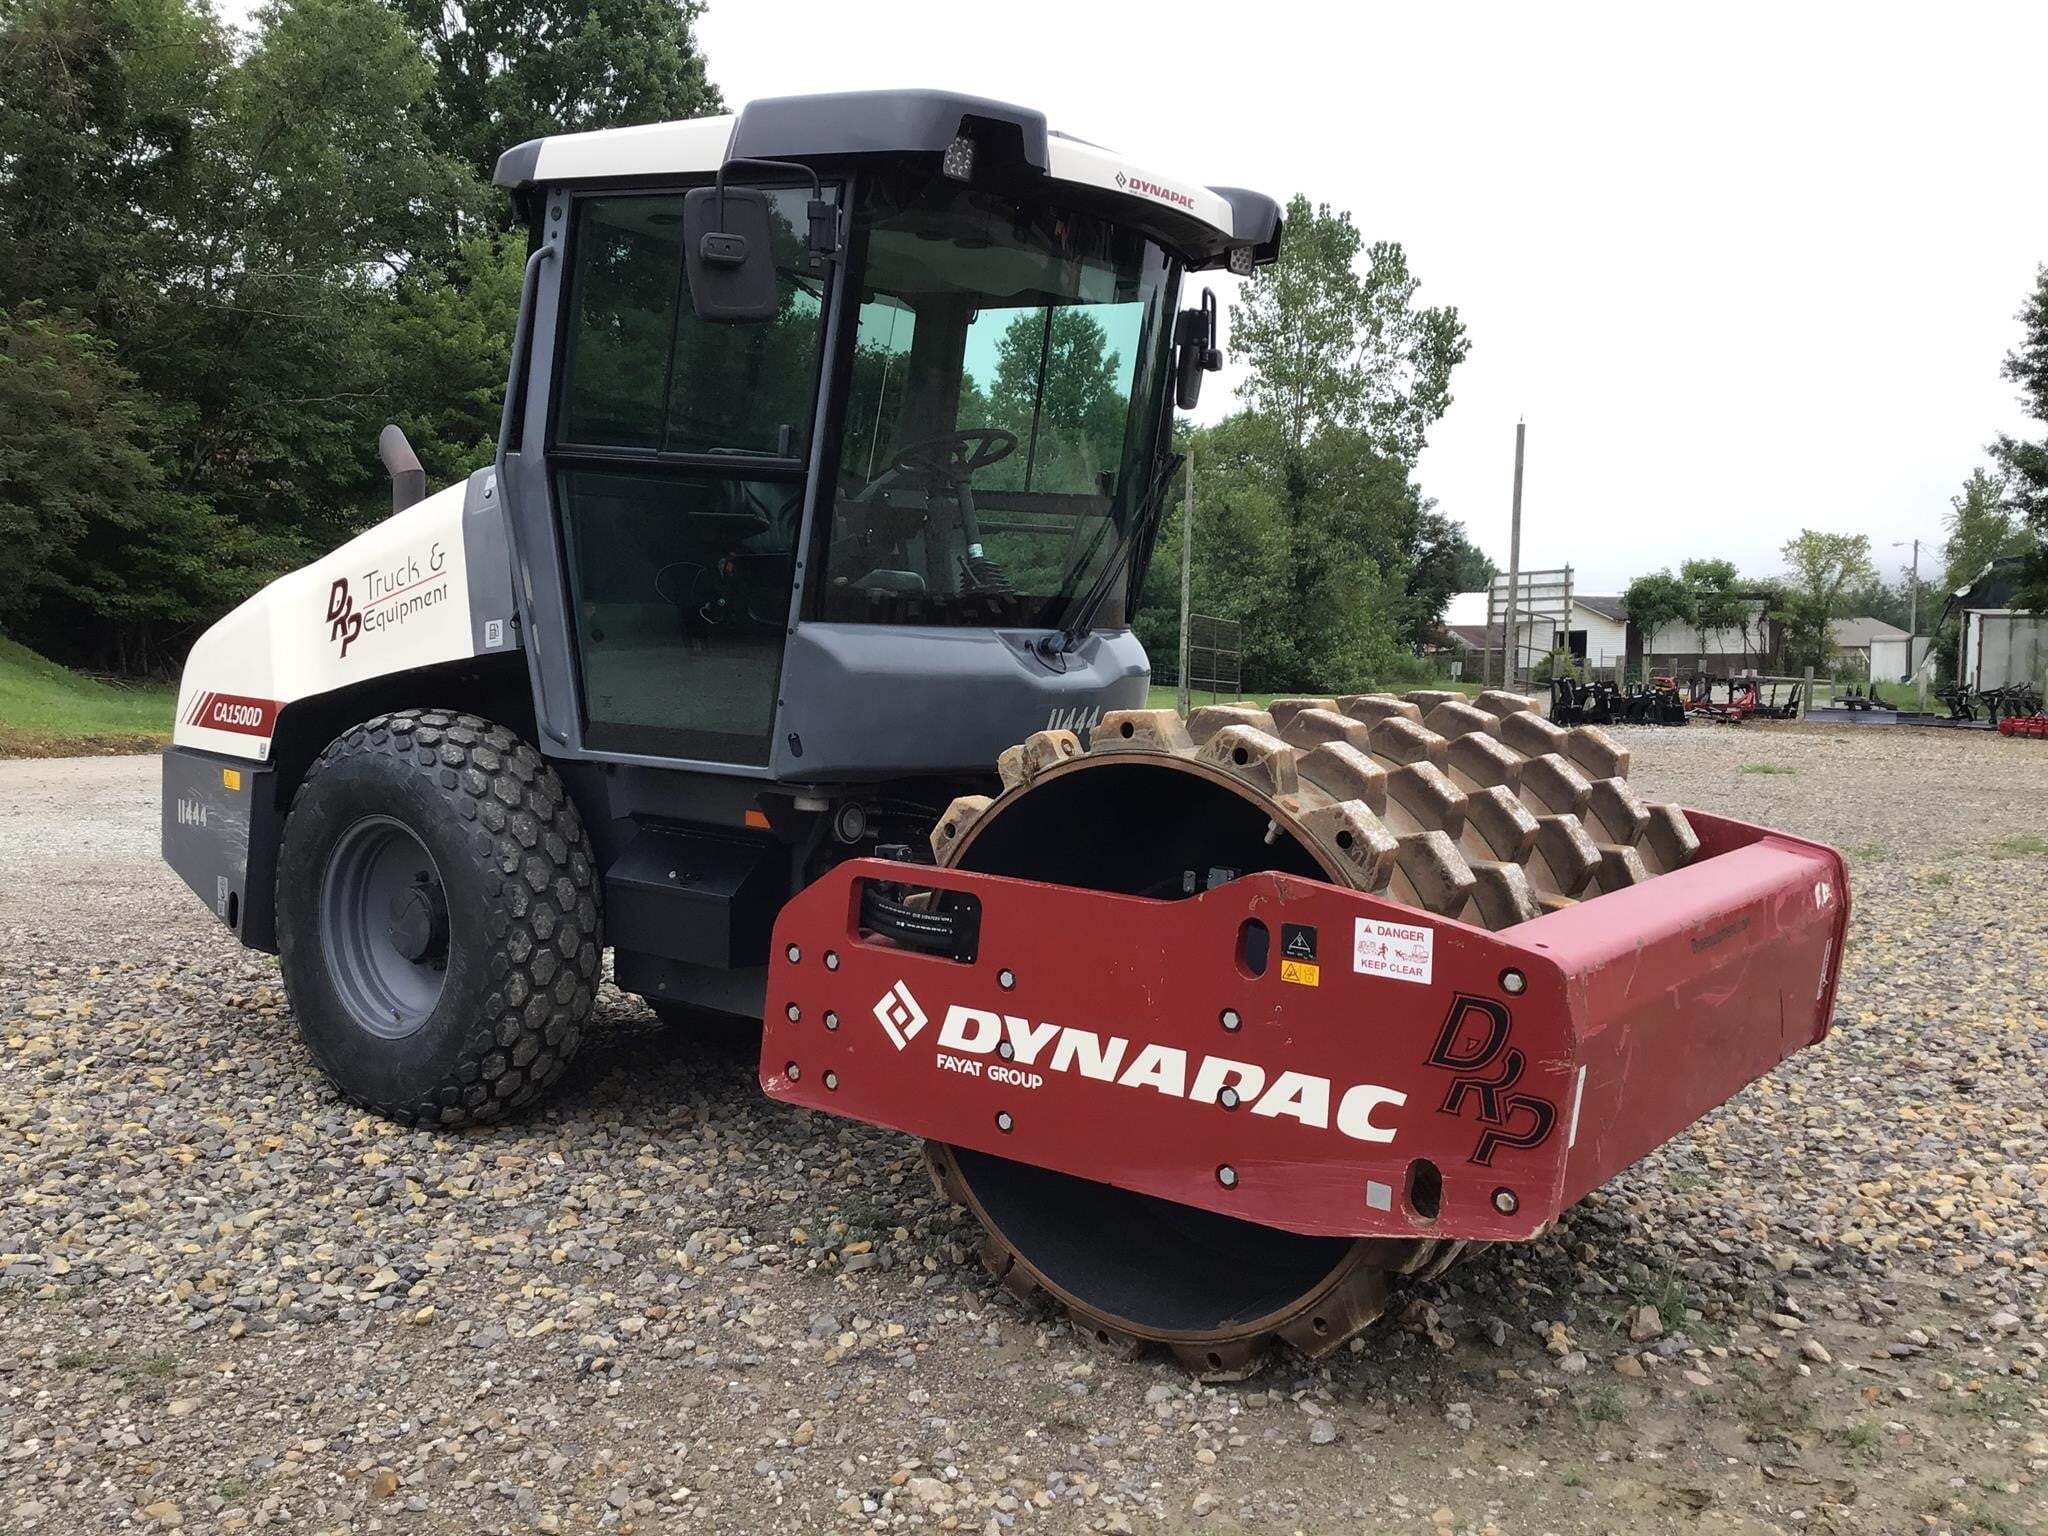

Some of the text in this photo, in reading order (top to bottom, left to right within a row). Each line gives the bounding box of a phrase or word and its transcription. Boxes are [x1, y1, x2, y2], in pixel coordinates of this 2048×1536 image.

[1129, 177, 1196, 210] DYNAPAC
[362, 542, 446, 601] Truck &
[363, 582, 448, 632] Equipment
[213, 702, 263, 727] CA1500D
[1377, 926, 1425, 942] DANGER
[1361, 959, 1423, 977] KEEP CLEAR
[936, 1053, 1043, 1090] FAYAT GROUP
[936, 1004, 1408, 1144] DYNAPAC
